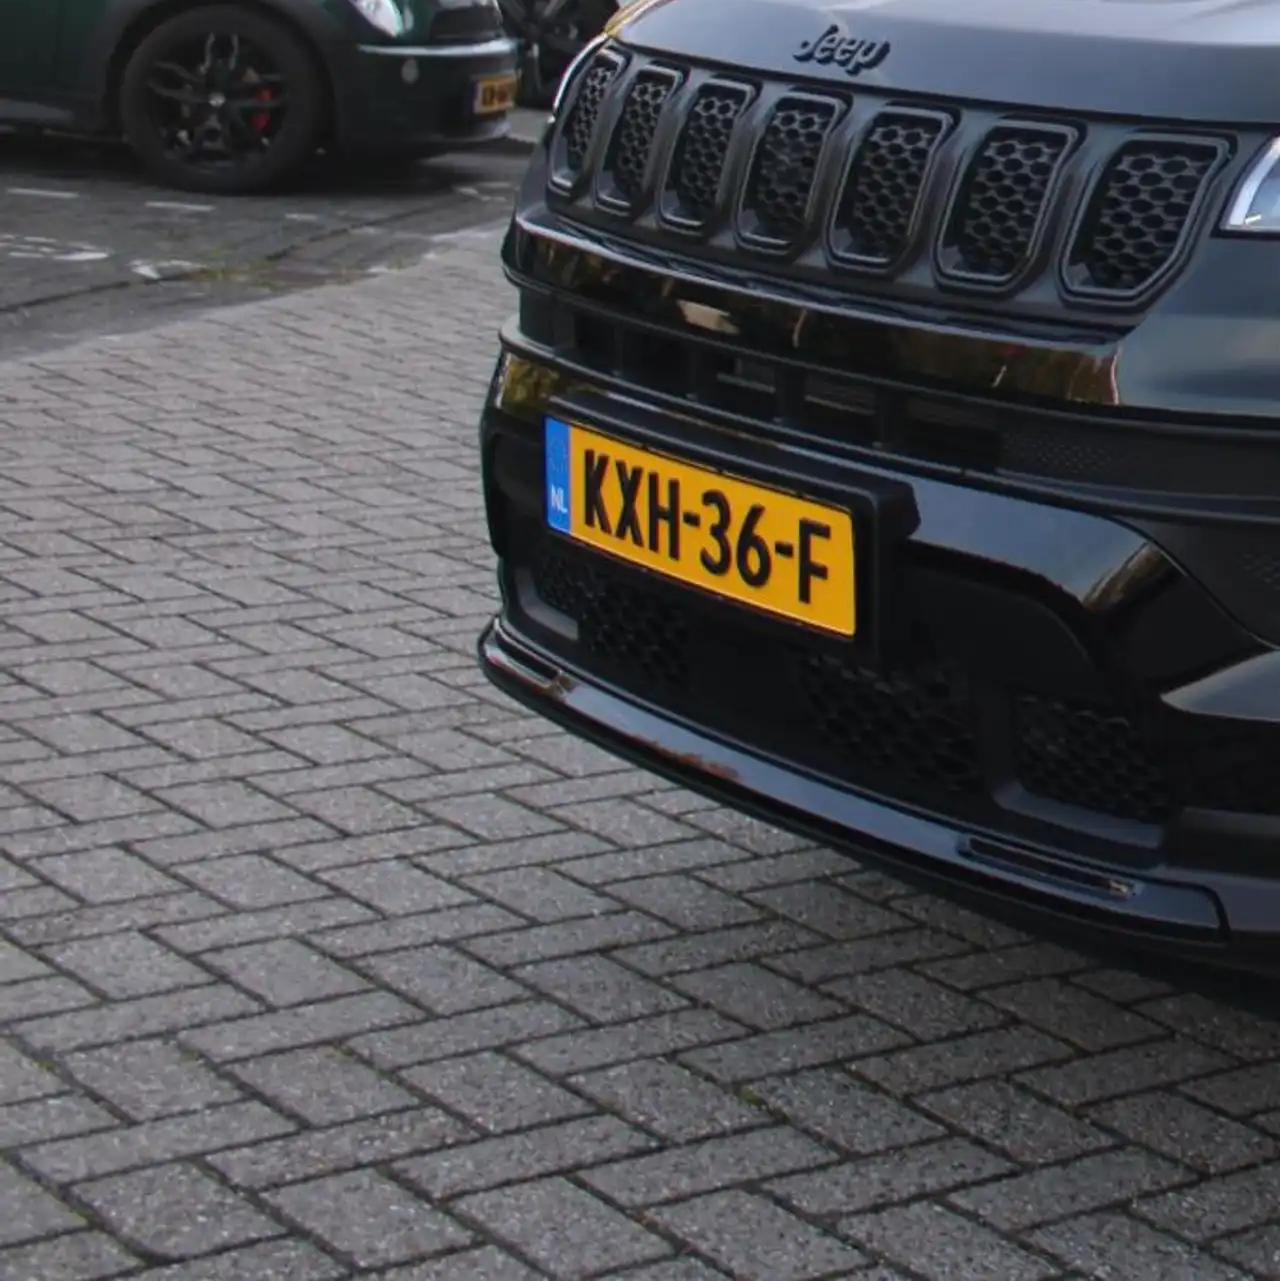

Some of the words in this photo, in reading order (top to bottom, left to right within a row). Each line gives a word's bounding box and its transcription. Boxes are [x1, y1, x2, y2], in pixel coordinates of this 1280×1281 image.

[792, 23, 891, 78] Jeep
[550, 483, 568, 514] NL
[584, 438, 831, 605] KXH-36-F
